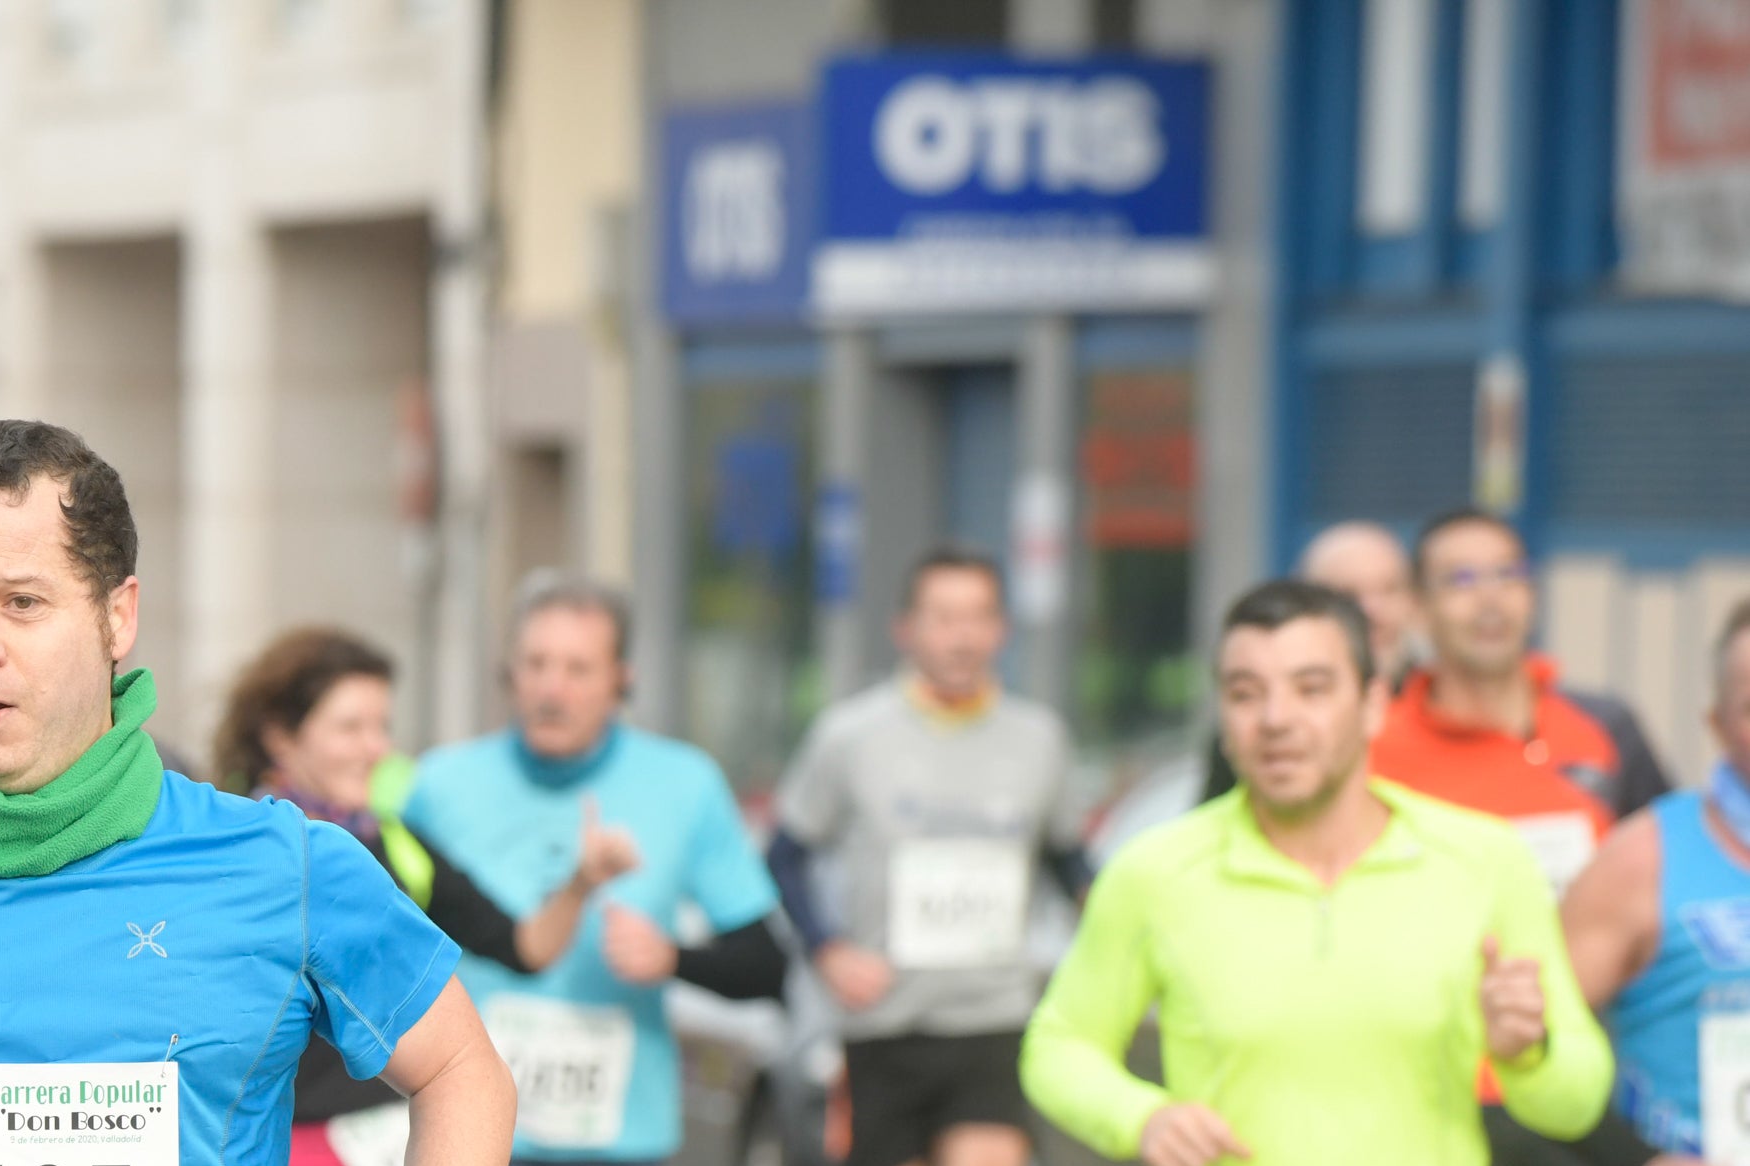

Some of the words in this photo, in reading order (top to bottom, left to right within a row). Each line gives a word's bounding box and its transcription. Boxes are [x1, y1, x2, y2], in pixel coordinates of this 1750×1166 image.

[872, 74, 1166, 195] OTIS
[79, 1080, 167, 1108] Popular
[17, 1135, 28, 1144] de
[29, 1135, 64, 1144] febrero
[65, 1135, 76, 1144] de
[77, 1134, 100, 1144] 2020,
[101, 1134, 142, 1144] Valladolid
